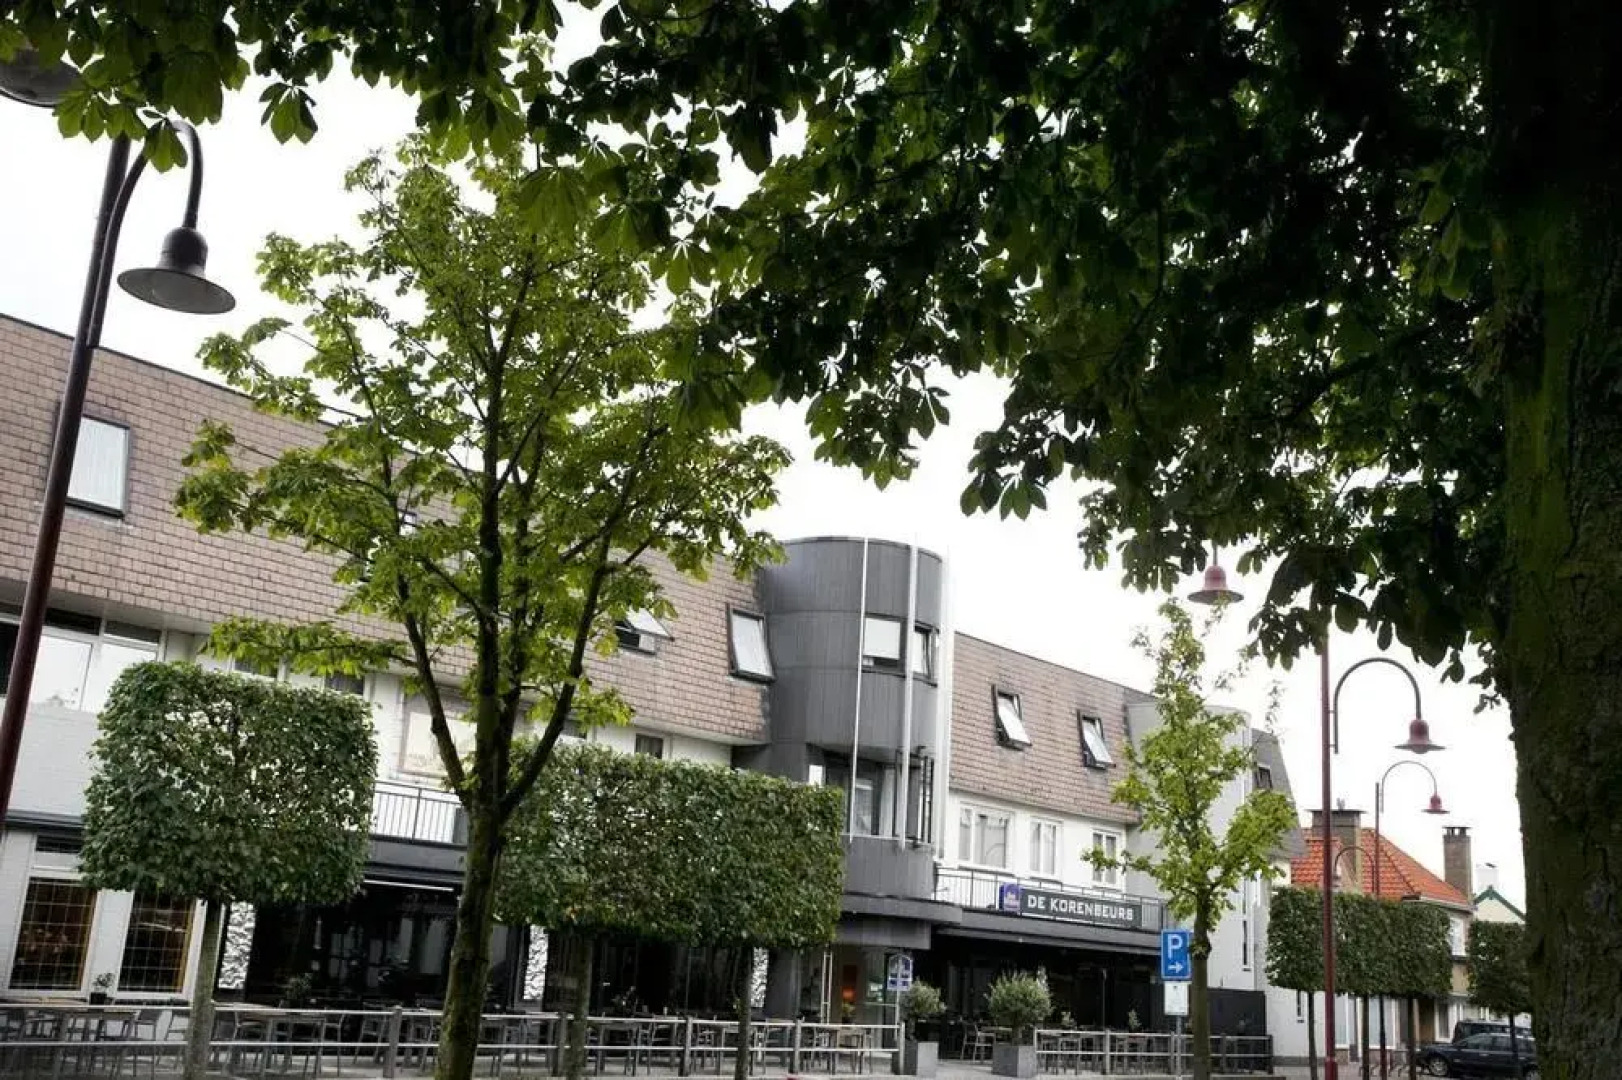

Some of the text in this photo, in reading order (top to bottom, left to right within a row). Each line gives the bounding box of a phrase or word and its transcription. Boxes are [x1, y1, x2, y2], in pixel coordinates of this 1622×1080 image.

[1027, 894, 1046, 909] DE
[1050, 897, 1134, 921] KORENBEURS
[1167, 933, 1183, 960] P
